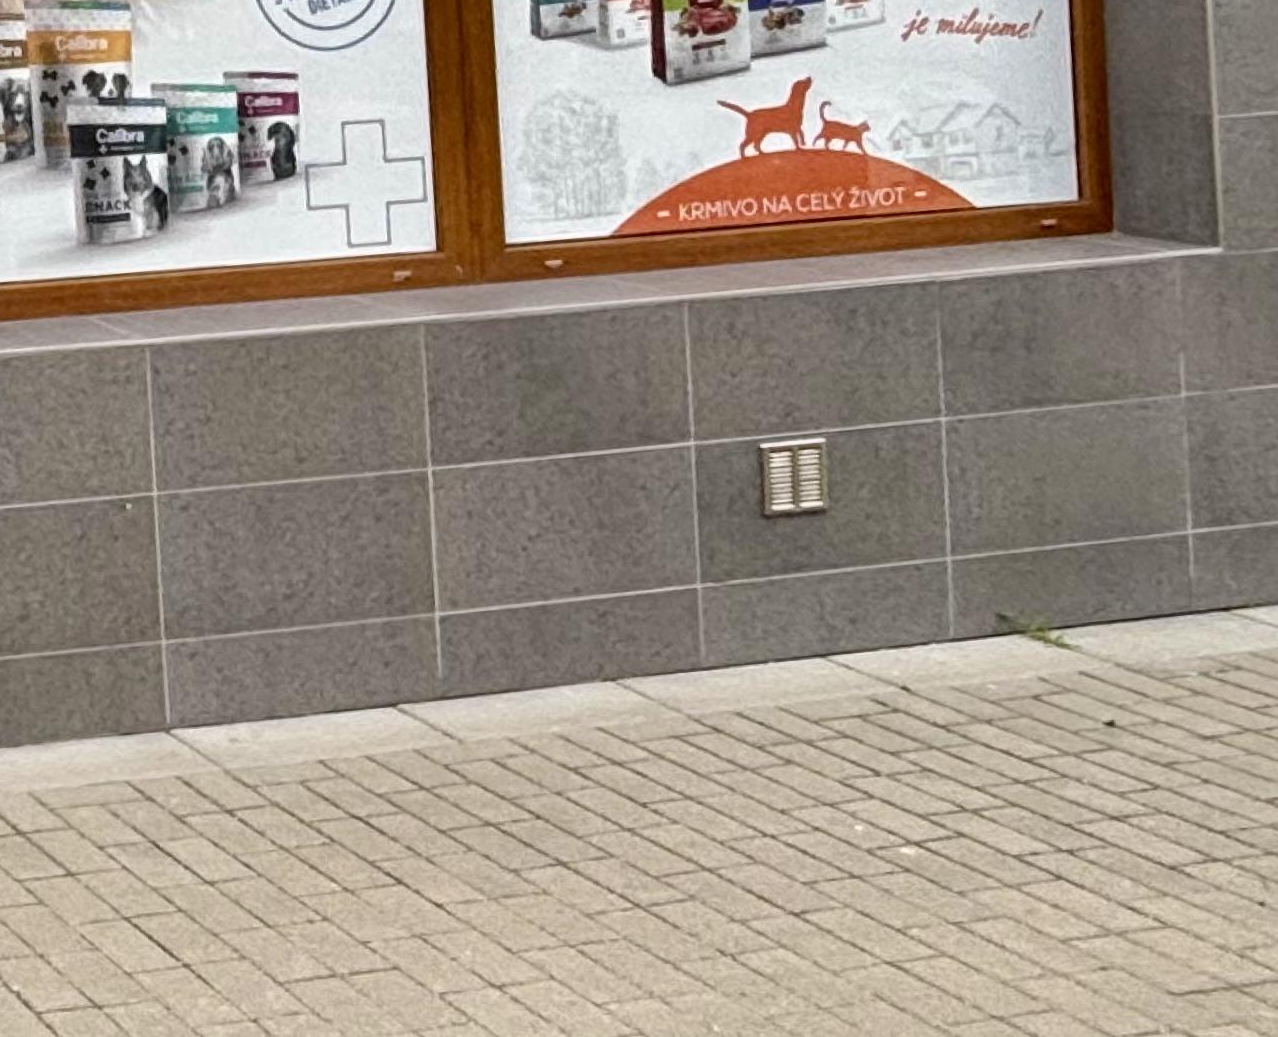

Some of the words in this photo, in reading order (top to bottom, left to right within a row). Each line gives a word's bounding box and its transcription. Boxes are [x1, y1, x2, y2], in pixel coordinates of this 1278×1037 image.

[901, 9, 930, 43] je
[936, 8, 1045, 44] milujeme!
[96, 127, 145, 144] Calibra
[678, 199, 758, 221] KRMIVO
[763, 195, 792, 213] NA
[795, 187, 845, 212] CELÝ
[849, 186, 907, 208] ŽIVOT
